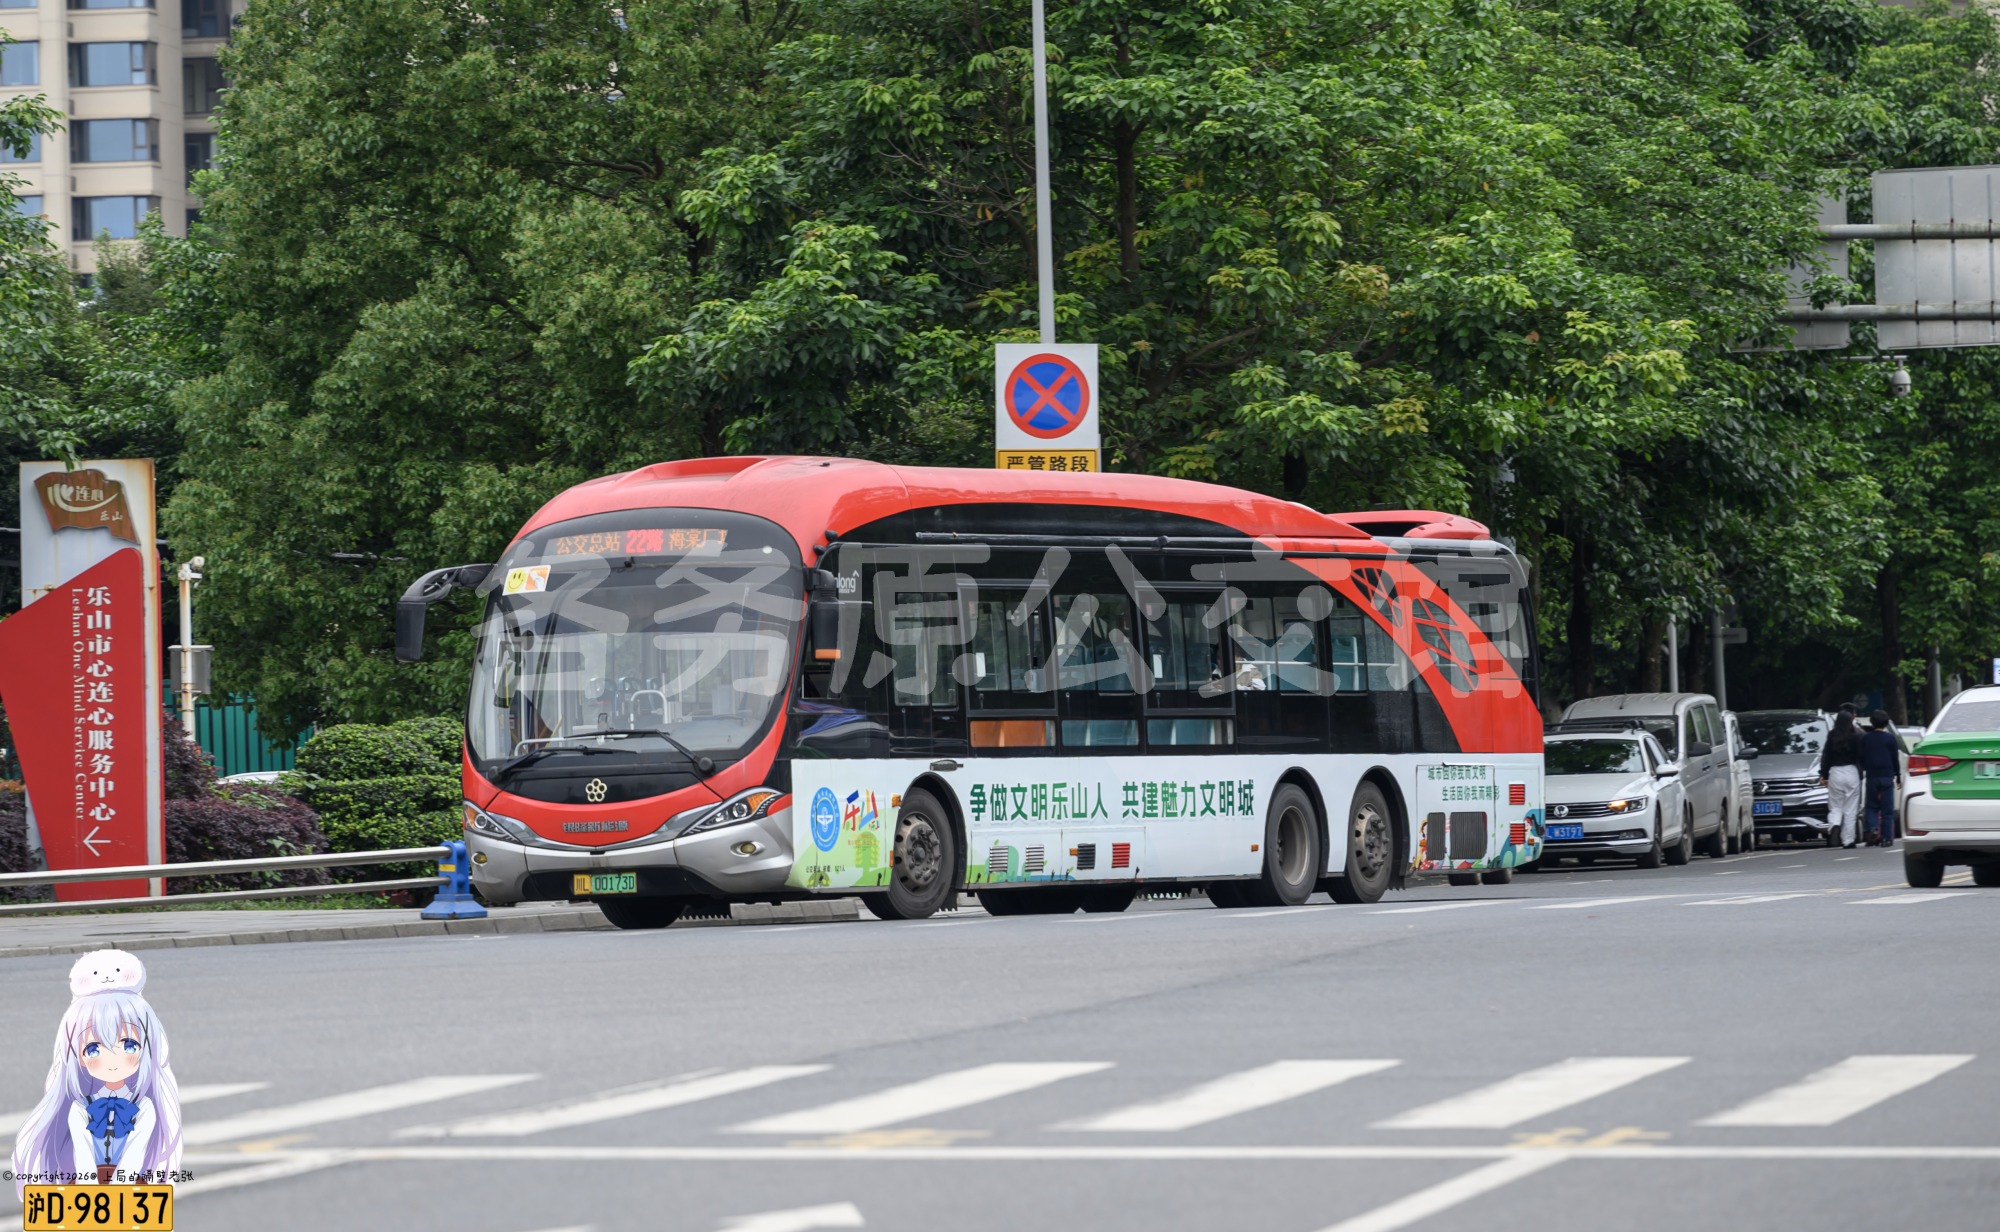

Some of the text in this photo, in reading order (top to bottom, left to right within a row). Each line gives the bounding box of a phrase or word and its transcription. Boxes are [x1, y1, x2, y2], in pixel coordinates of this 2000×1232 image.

[1007, 455, 1089, 472] 严管路段
[100, 511, 123, 521] 乐山
[556, 532, 621, 555] 公交总站
[626, 529, 664, 554] 22路
[71, 588, 88, 820] Leshan One Mind Service Center
[86, 586, 115, 821] 乐山市心连心服务中心
[1428, 766, 1486, 780] 城市因你我而文明
[969, 779, 1255, 822] 争做文明乐山人 共建魅力文明城
[1442, 785, 1500, 801] 生活因你我而精彩
